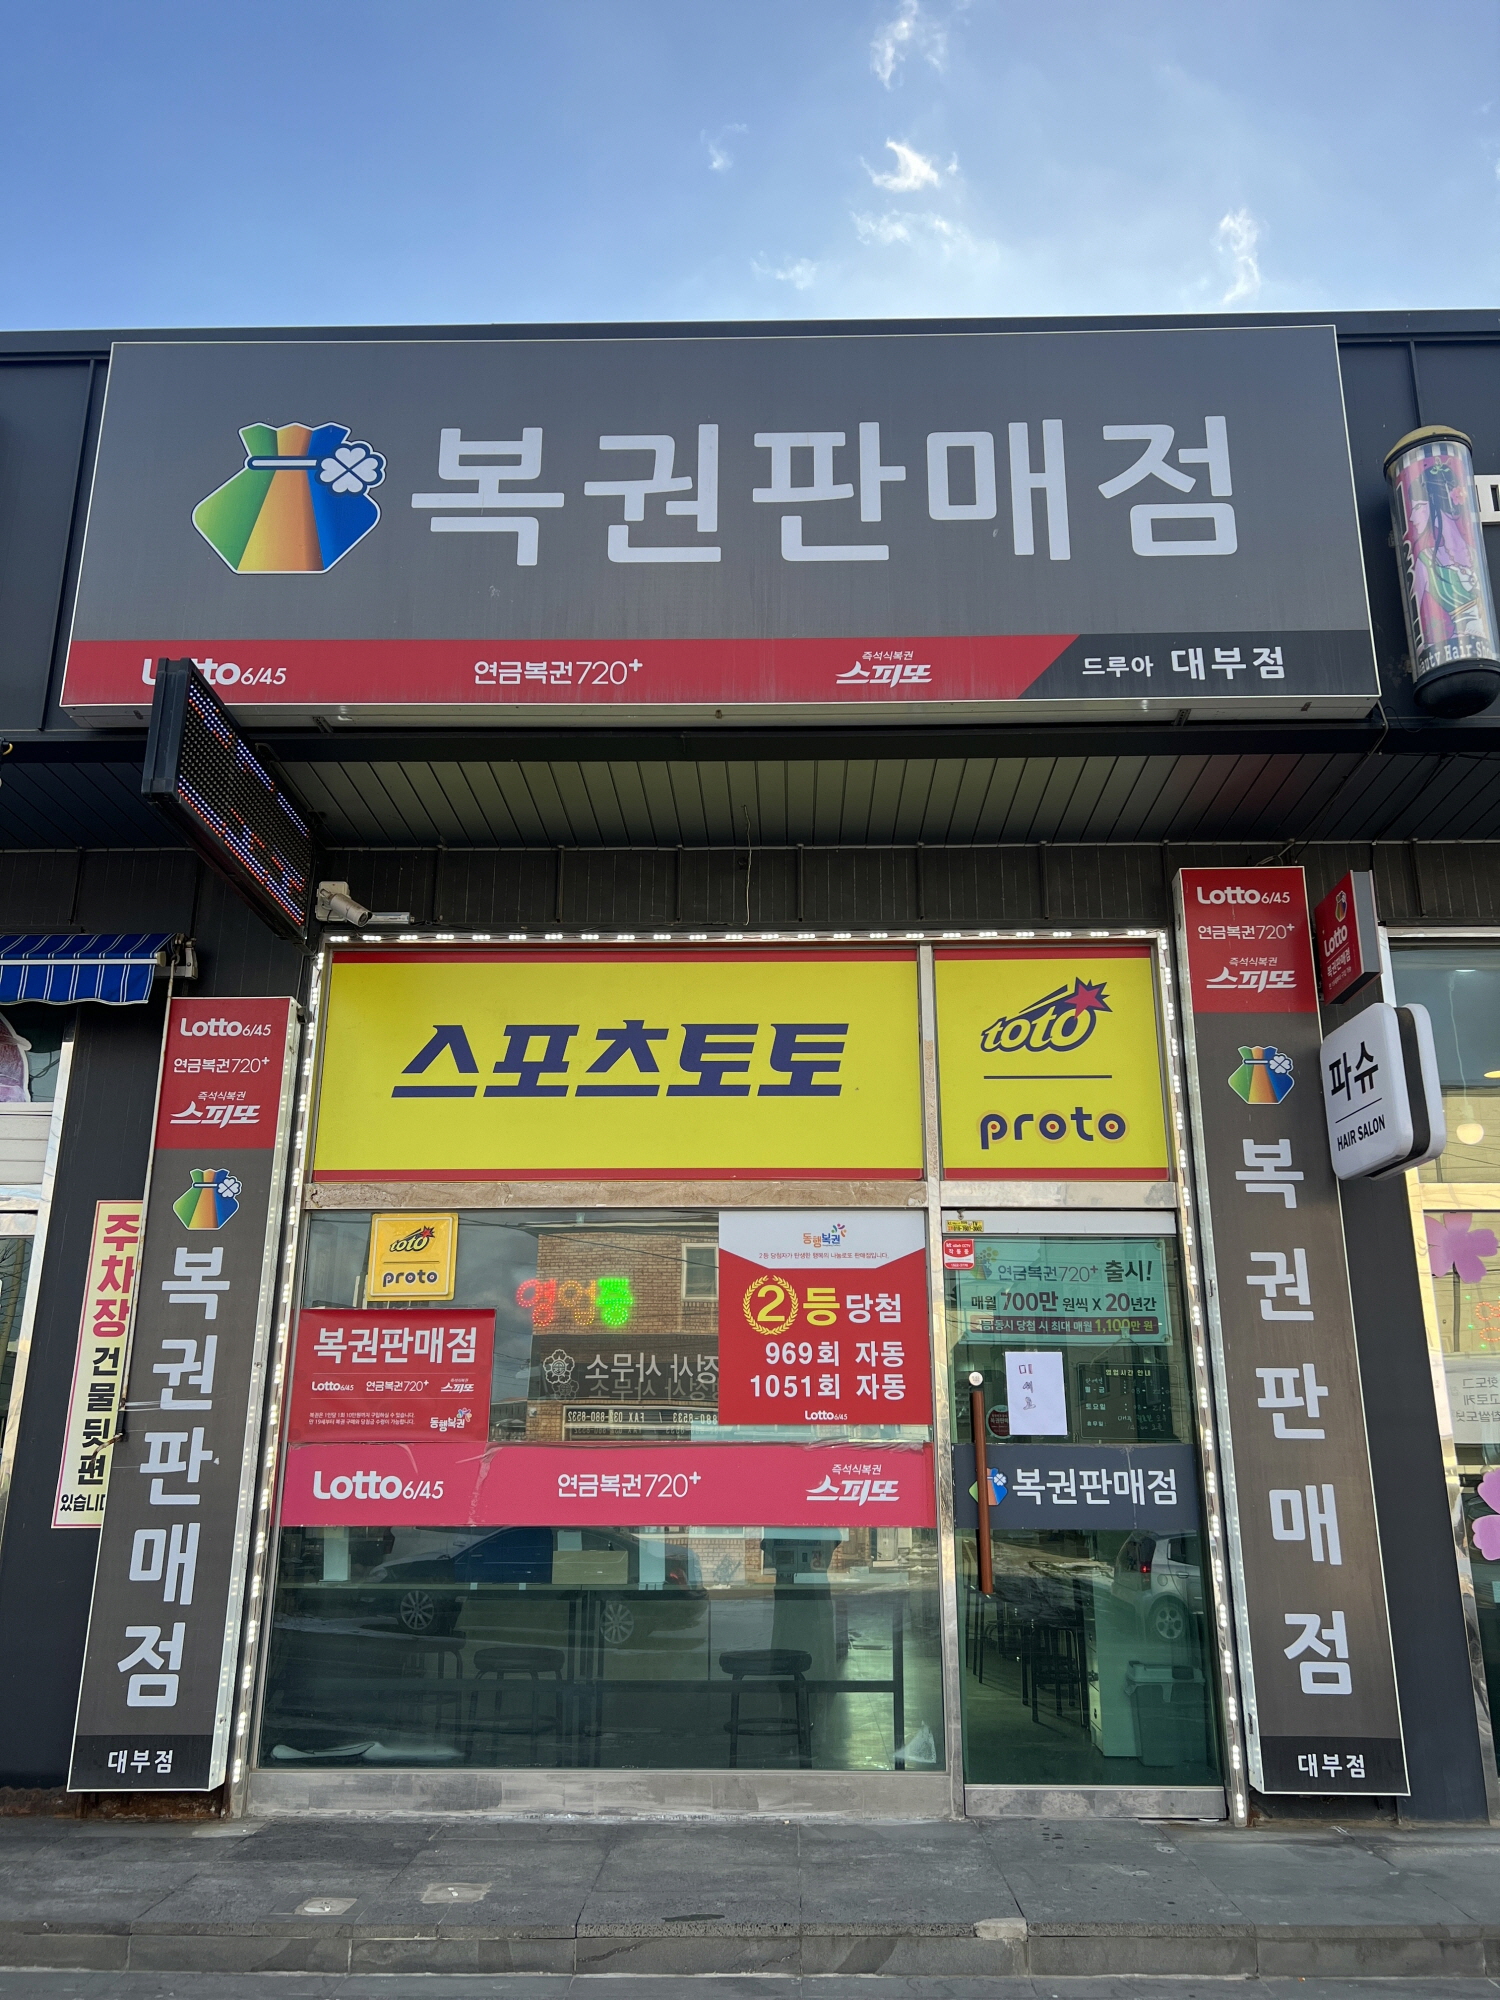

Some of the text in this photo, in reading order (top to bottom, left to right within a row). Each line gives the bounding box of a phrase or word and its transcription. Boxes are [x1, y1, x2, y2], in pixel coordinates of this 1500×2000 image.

[411, 415, 1237, 565] 복권판매점
[862, 651, 914, 661] 즉석식복권
[1082, 646, 1286, 681] 드루아 대부점
[836, 661, 932, 688] 스피또
[1323, 925, 1348, 957] Lotto
[1229, 957, 1278, 967] 즉석식복권
[1327, 947, 1351, 977] 복권판매점
[1205, 966, 1297, 993] 스피또
[979, 995, 1099, 1053] toto
[391, 1020, 849, 1098] 스포츠토토
[1329, 1041, 1379, 1101] 파슈
[198, 1091, 247, 1101] 즉석식복권
[170, 1101, 261, 1129] 스피또
[980, 1106, 1127, 1150] proto
[1337, 1114, 1386, 1152] HAIR SALON
[803, 1233, 841, 1248] 동행복권
[93, 1214, 140, 1338] 주차장
[382, 1269, 438, 1288] proto
[1104, 1260, 1153, 1283] 출시!
[515, 1277, 634, 1327] 영업중
[845, 1292, 902, 1324] 당첨
[971, 1296, 997, 1311] 매월
[1001, 1291, 1059, 1312] 700만
[1062, 1297, 1089, 1312] 원씩
[994, 1319, 1014, 1331] 동시
[1016, 1320, 1036, 1332] 당첨
[1038, 1320, 1049, 1332] 시
[1051, 1320, 1070, 1332] 최대
[1073, 1320, 1093, 1332] 매월
[1143, 1320, 1153, 1331] 원
[313, 1326, 477, 1365] 복권판매점
[764, 1340, 905, 1367] 969회 자동
[750, 1373, 841, 1400] 1051회
[855, 1372, 906, 1401] 자동
[1136, 1369, 1151, 1377] 안내
[440, 1382, 474, 1393] 스피또
[1085, 1403, 1106, 1411] 토요일
[1235, 1138, 1353, 1695] 복권판매점
[429, 1416, 465, 1432] 동행복권
[116, 1246, 231, 1708] 복권판매점
[831, 1463, 882, 1475] 즉석식복권
[805, 1474, 900, 1507] 스피또
[1012, 1467, 1178, 1506] 복권판매점
[107, 1749, 174, 1774] 대부점
[1297, 1753, 1366, 1778] 대부점
